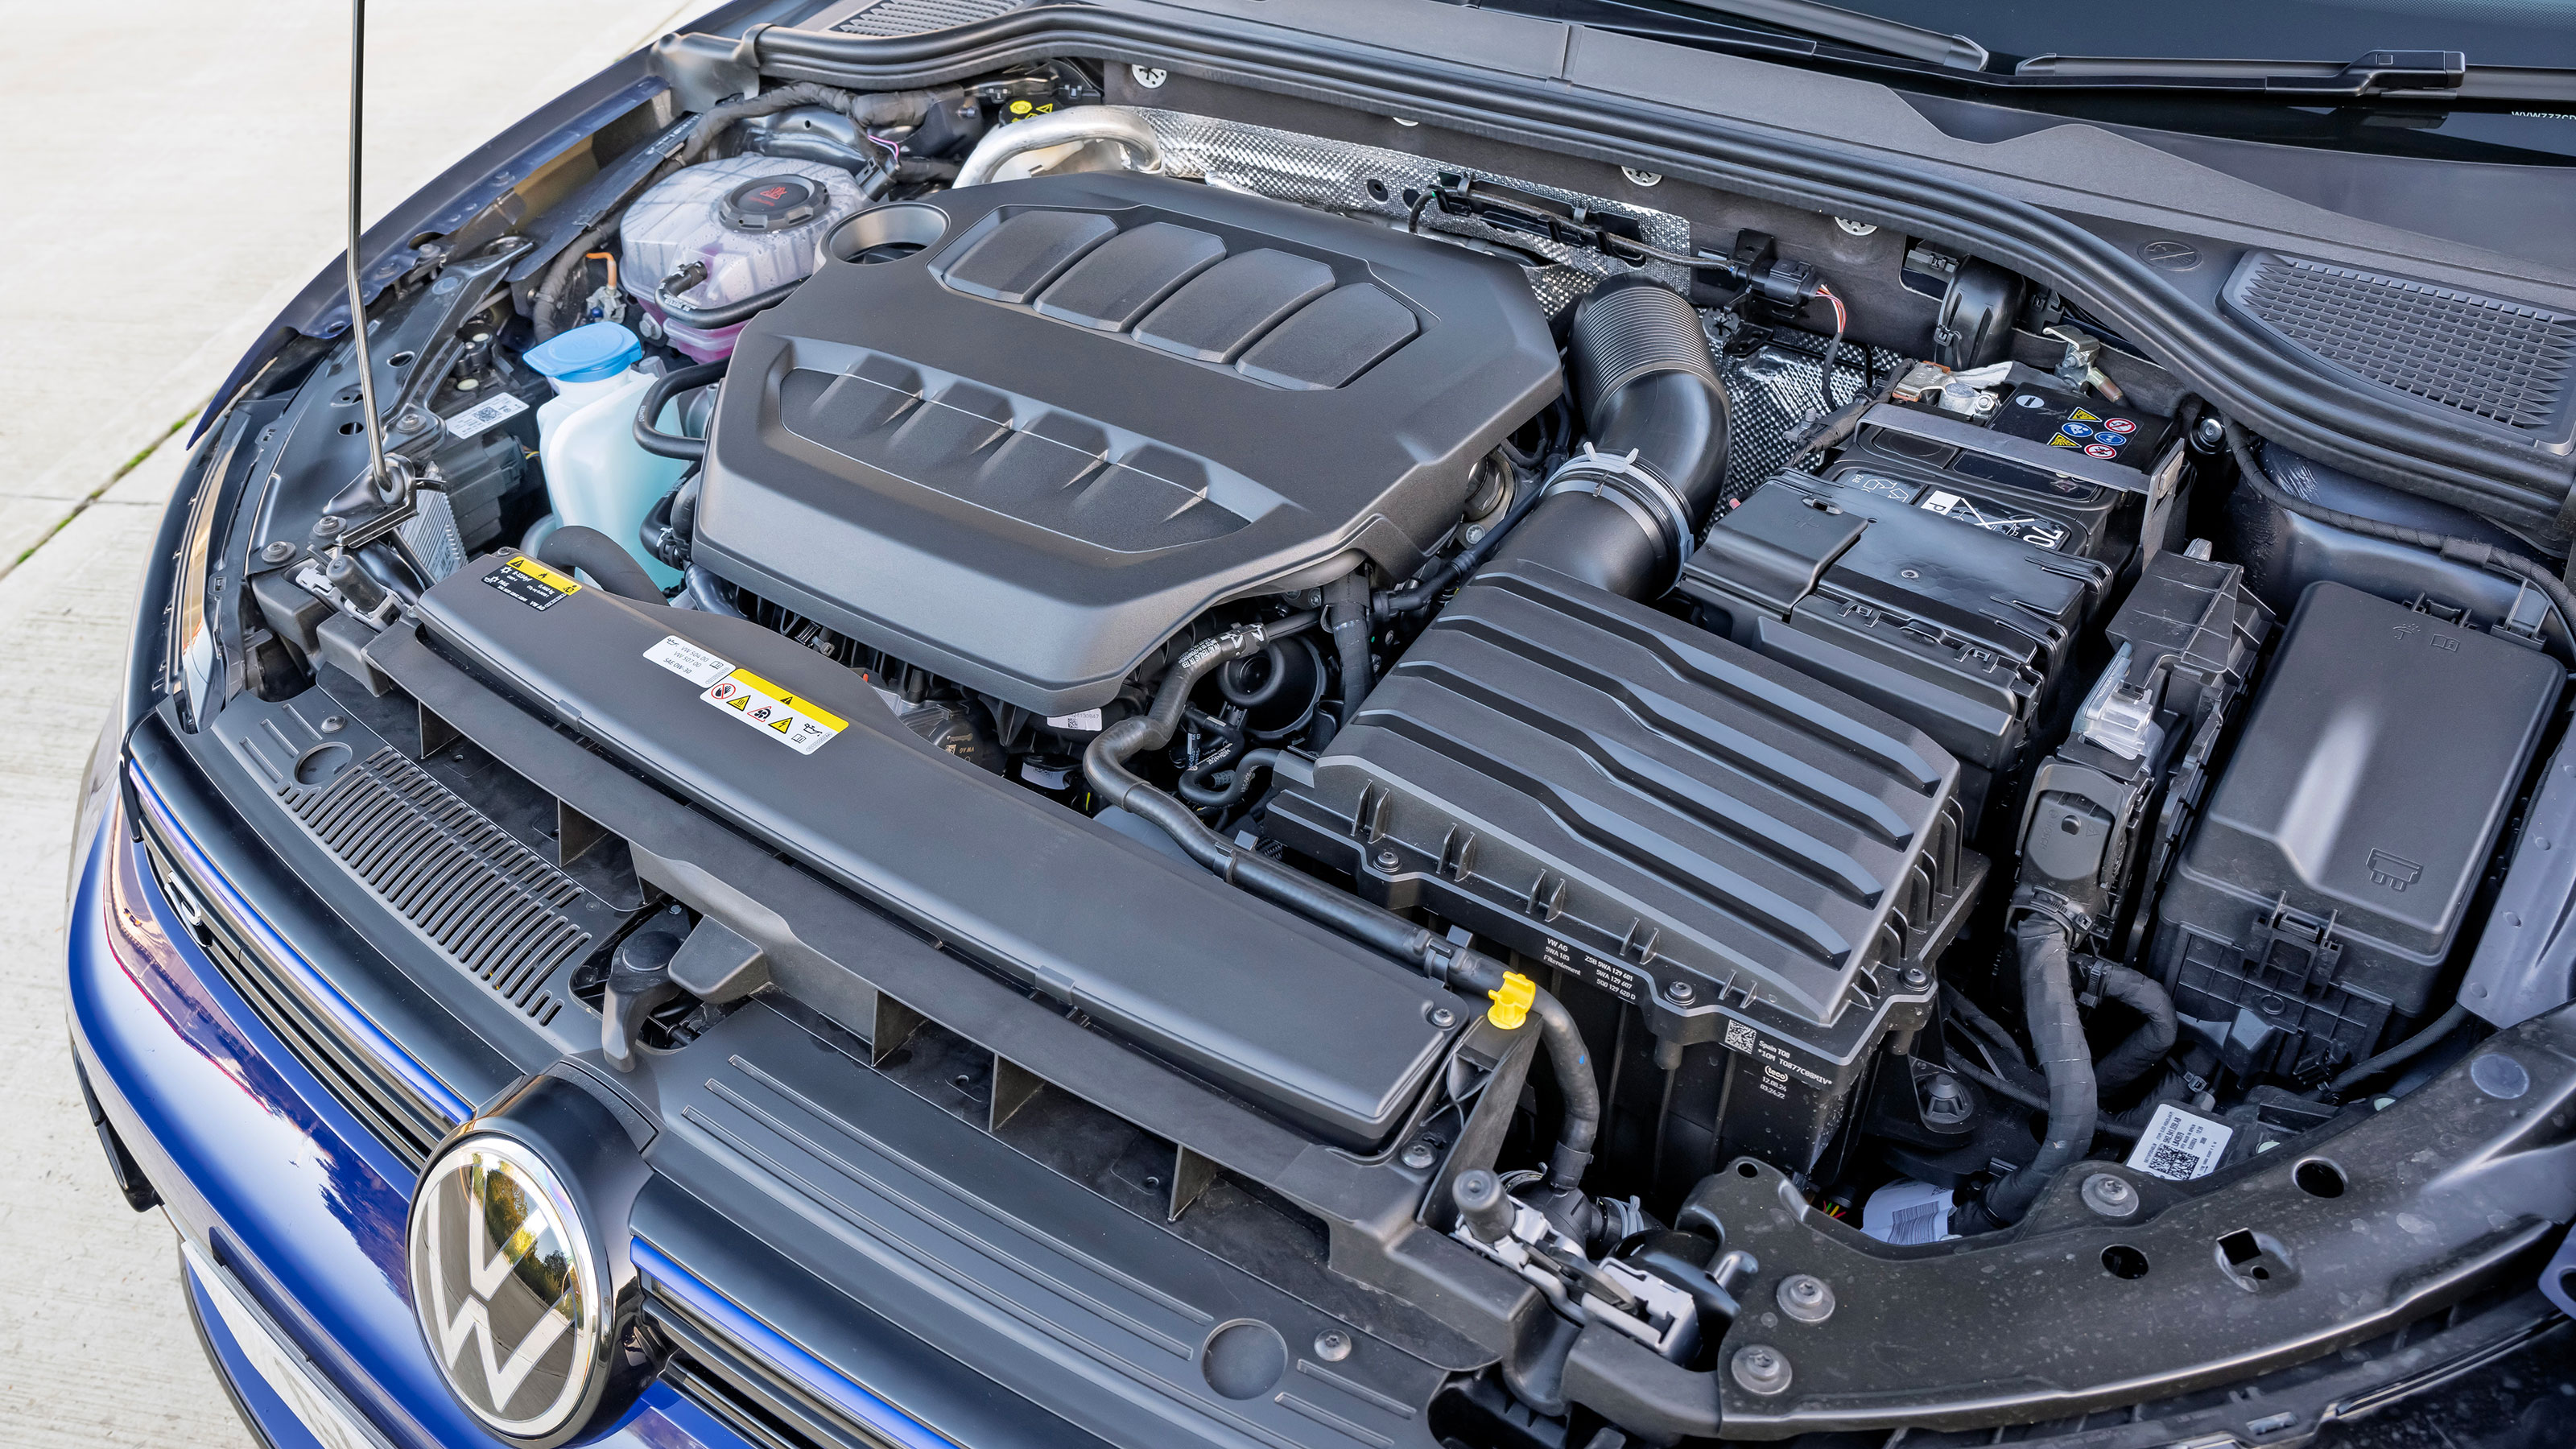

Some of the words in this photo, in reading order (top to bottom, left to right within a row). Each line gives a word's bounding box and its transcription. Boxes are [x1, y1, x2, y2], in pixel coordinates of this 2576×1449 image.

[2022, 525, 2065, 548] 70
[681, 646, 691, 654] VW
[689, 650, 700, 658] 504
[673, 663, 692, 675] 0W-30
[1546, 937, 1558, 947] VW
[1558, 943, 1568, 952] AG
[1545, 946, 1558, 957] 5WA
[1559, 953, 1570, 961] 183
[1584, 955, 1597, 965] ZSB
[1597, 961, 1612, 972] 5WA
[1612, 968, 1623, 976] 129
[1623, 973, 1633, 982] 601
[1596, 969, 1610, 980] 5WA
[1611, 976, 1621, 985] 129
[1621, 981, 1633, 990] 607
[1609, 984, 1620, 993] 129
[1620, 989, 1631, 998] 620
[1758, 1040, 1777, 1053] Spain
[1768, 1067, 1786, 1080] teco
